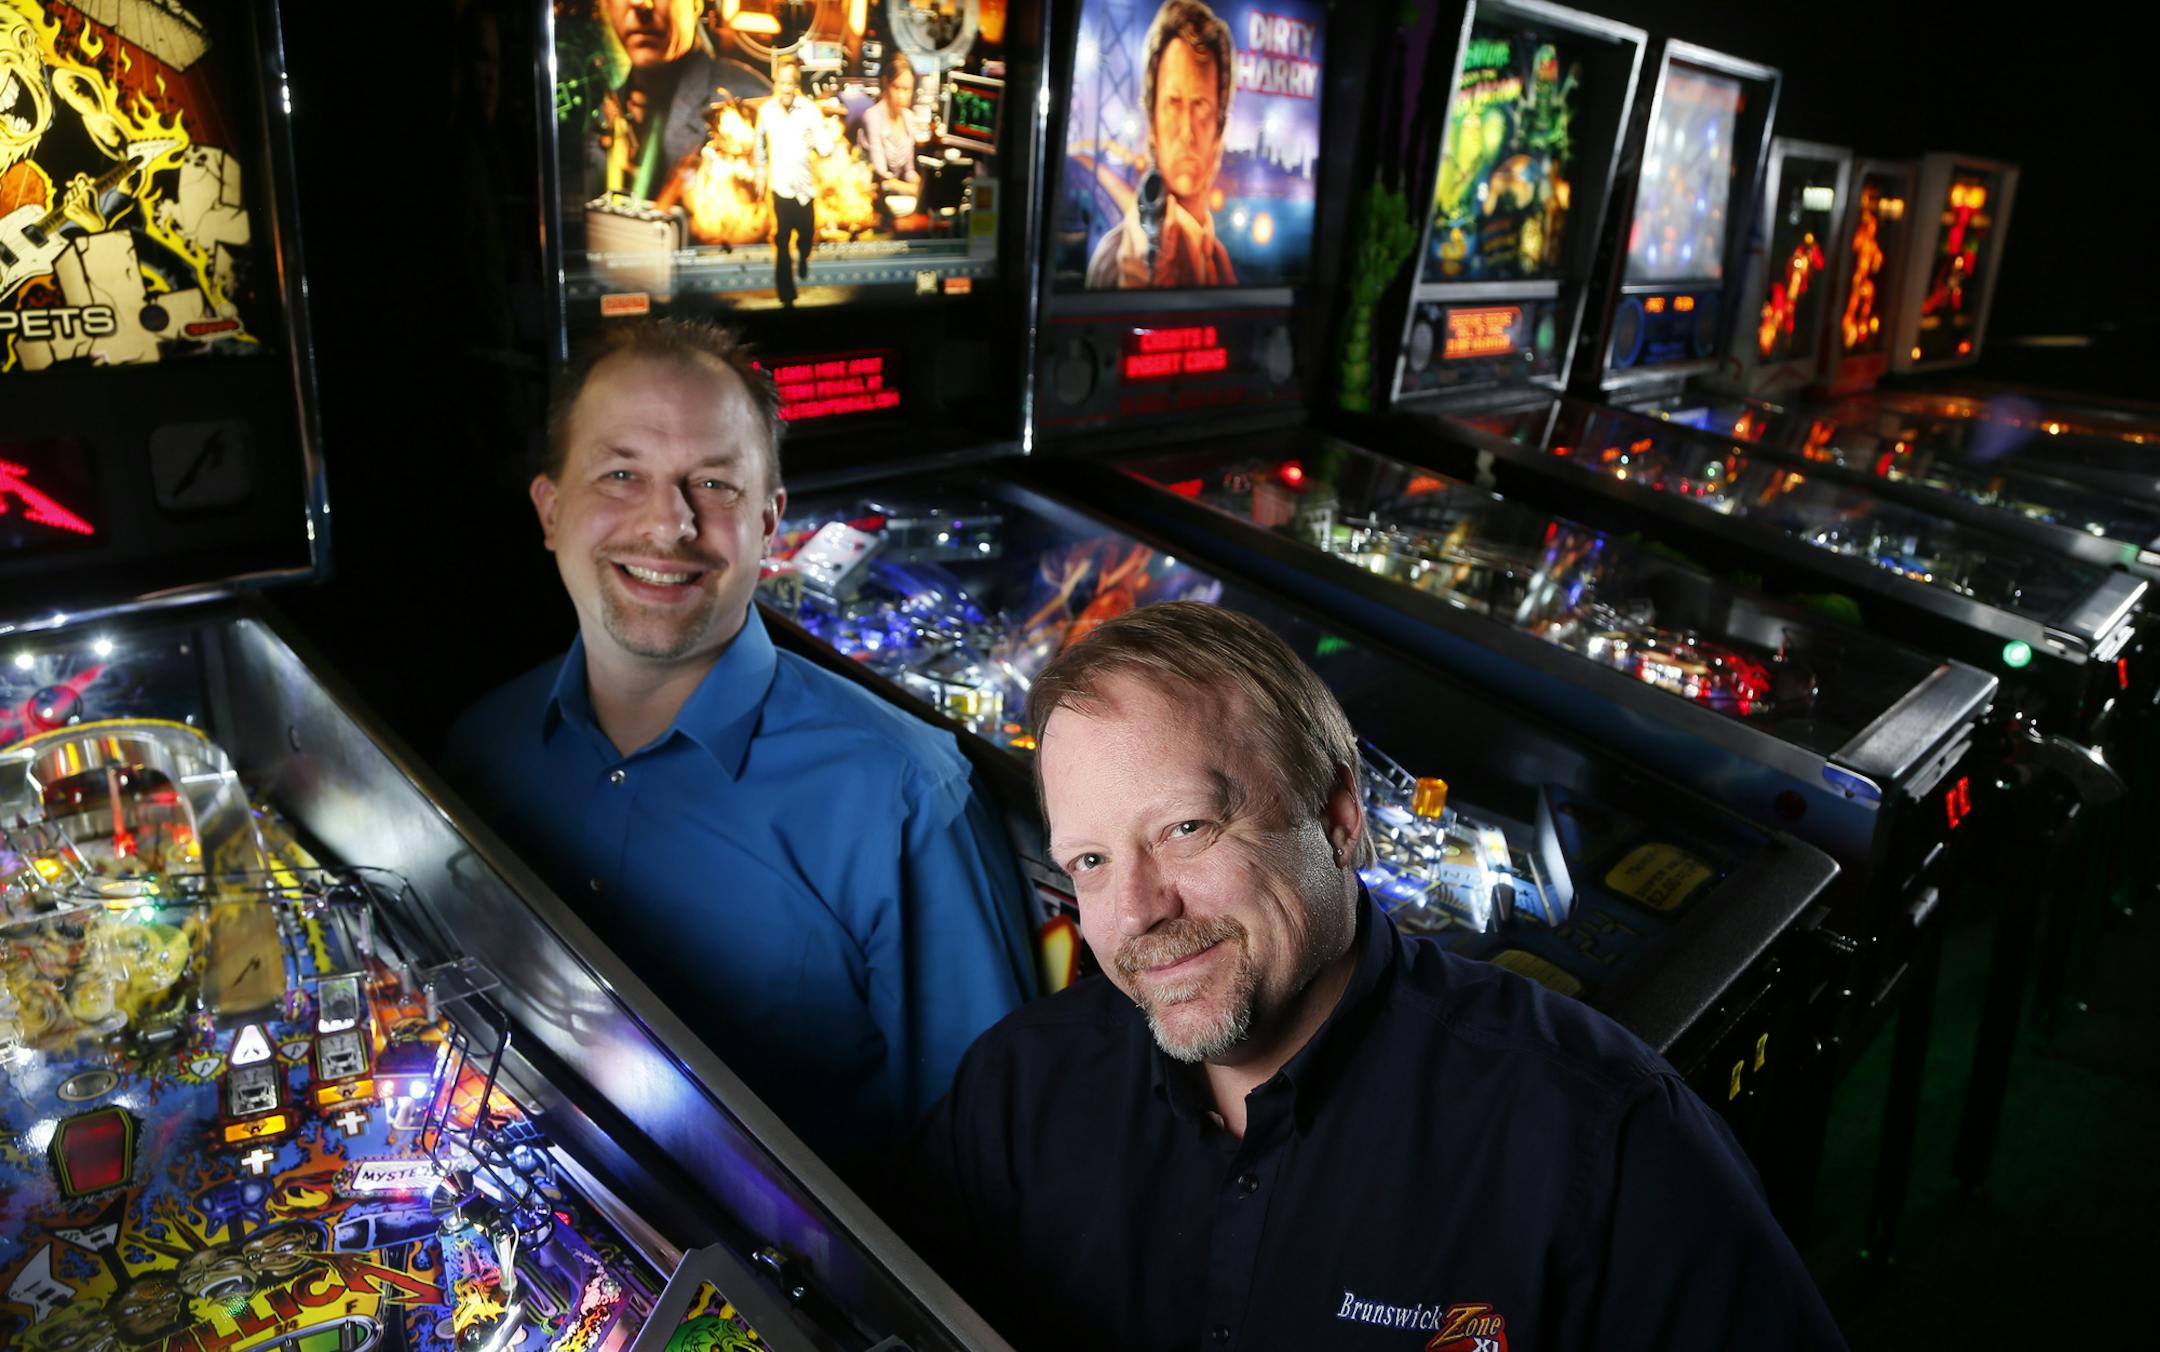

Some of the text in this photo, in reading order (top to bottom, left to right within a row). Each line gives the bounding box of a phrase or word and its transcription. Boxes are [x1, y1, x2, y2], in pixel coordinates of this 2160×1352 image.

[1248, 10, 1314, 60] DIRTY
[1236, 50, 1319, 98] HARRY
[345, 1299, 359, 1314] F
[1337, 1292, 1501, 1348] Brunswick Zone
